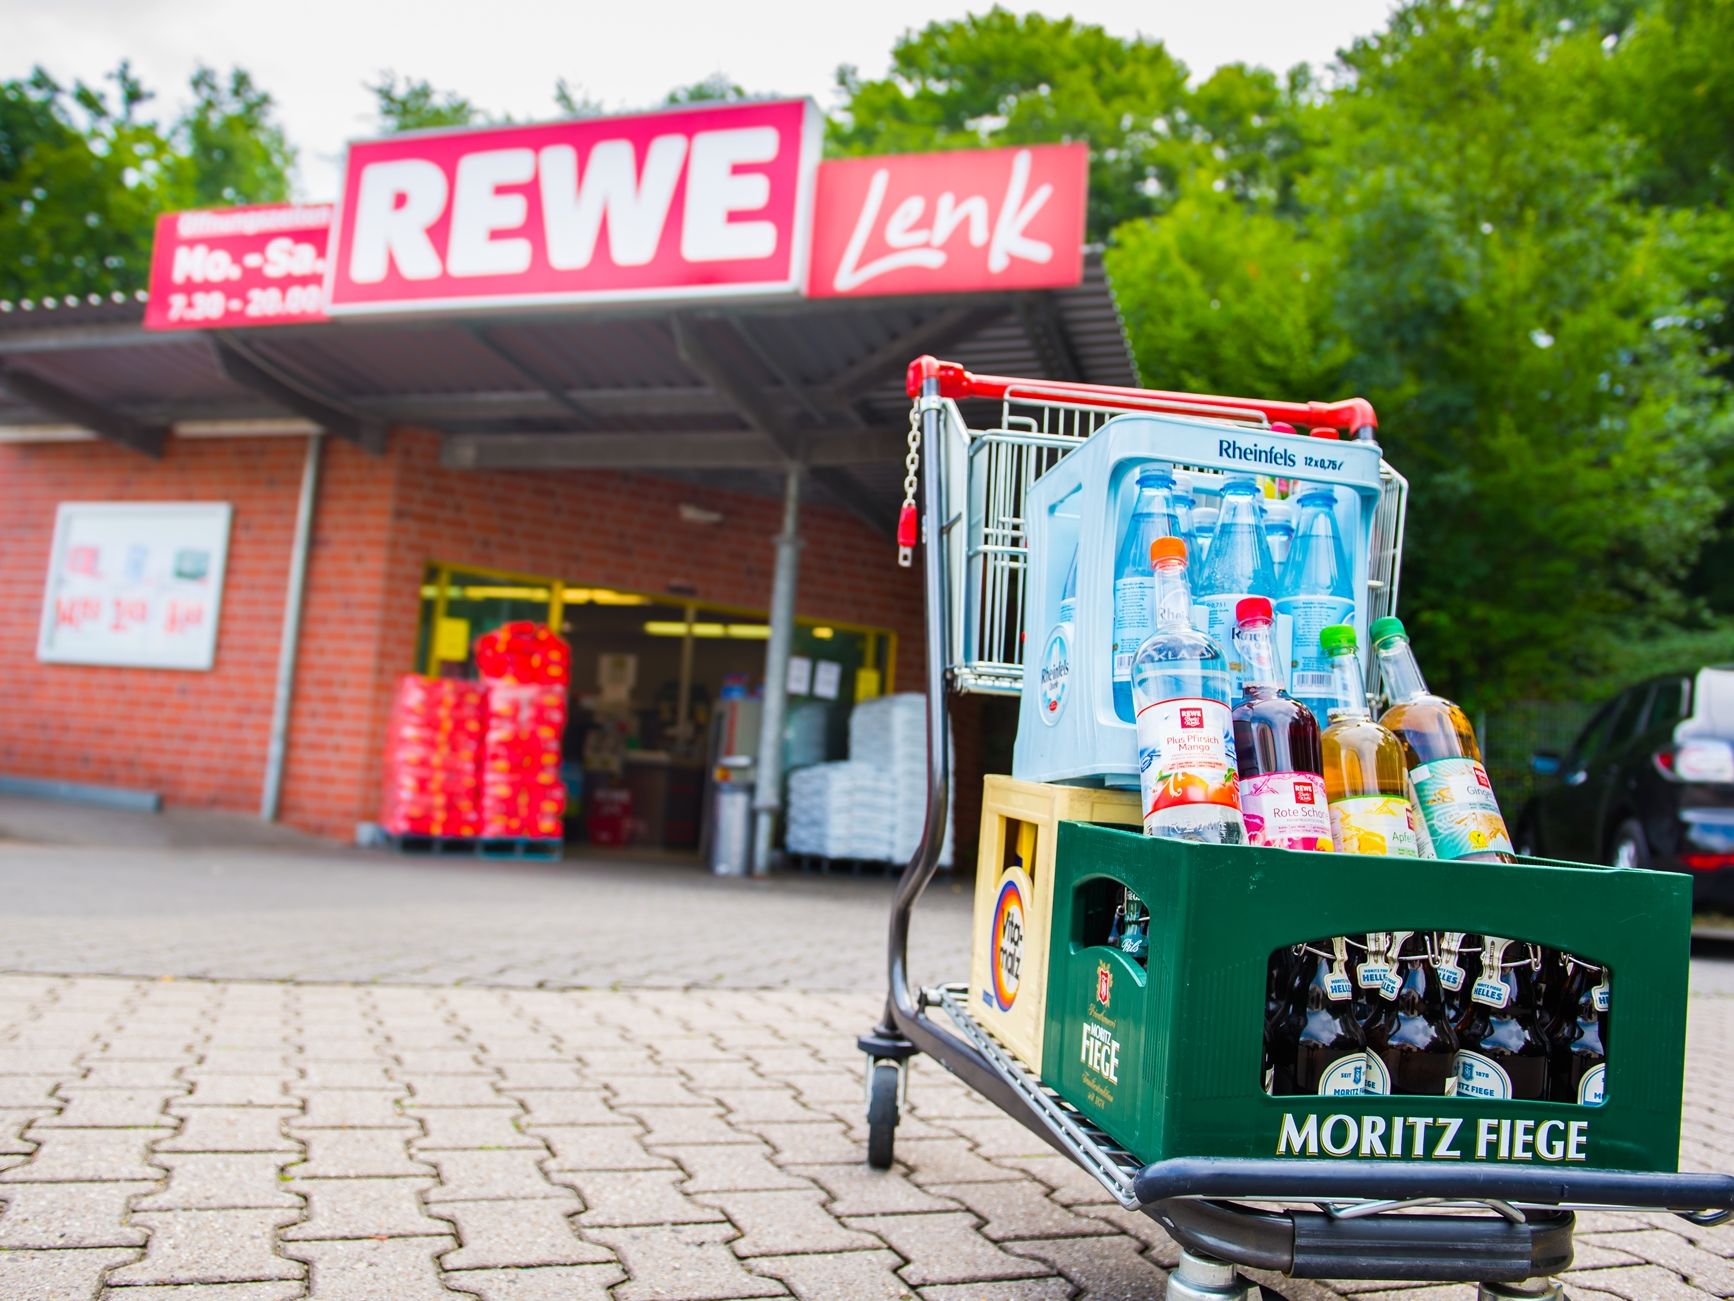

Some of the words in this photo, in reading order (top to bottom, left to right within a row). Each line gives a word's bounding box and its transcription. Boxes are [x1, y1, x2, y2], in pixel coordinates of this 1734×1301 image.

[348, 125, 781, 283] REWE
[832, 148, 1053, 292] Lenk
[167, 290, 226, 322] 7.30
[1218, 439, 1296, 467] Rheinfels
[1041, 659, 1069, 685] Rheinfels
[1181, 710, 1201, 718] REWE
[1167, 737, 1185, 745] Plus
[1187, 734, 1219, 745] Pfirsich
[1178, 743, 1210, 752] Mango
[1273, 807, 1299, 818] Rote
[1121, 938, 1142, 953] Pils
[1362, 974, 1386, 982] HELL
[1331, 984, 1352, 993] HELLE
[1474, 987, 1503, 1001] HELLES
[1090, 1021, 1112, 1047] MORITZ
[1080, 1022, 1120, 1086] FIEGE
[1365, 1080, 1376, 1089] EGE
[1471, 1086, 1495, 1097] FIEGE
[1333, 1088, 1359, 1096] MORITZ
[1276, 1113, 1463, 1158] MORITZ
[1475, 1118, 1588, 1161] FIEGE
